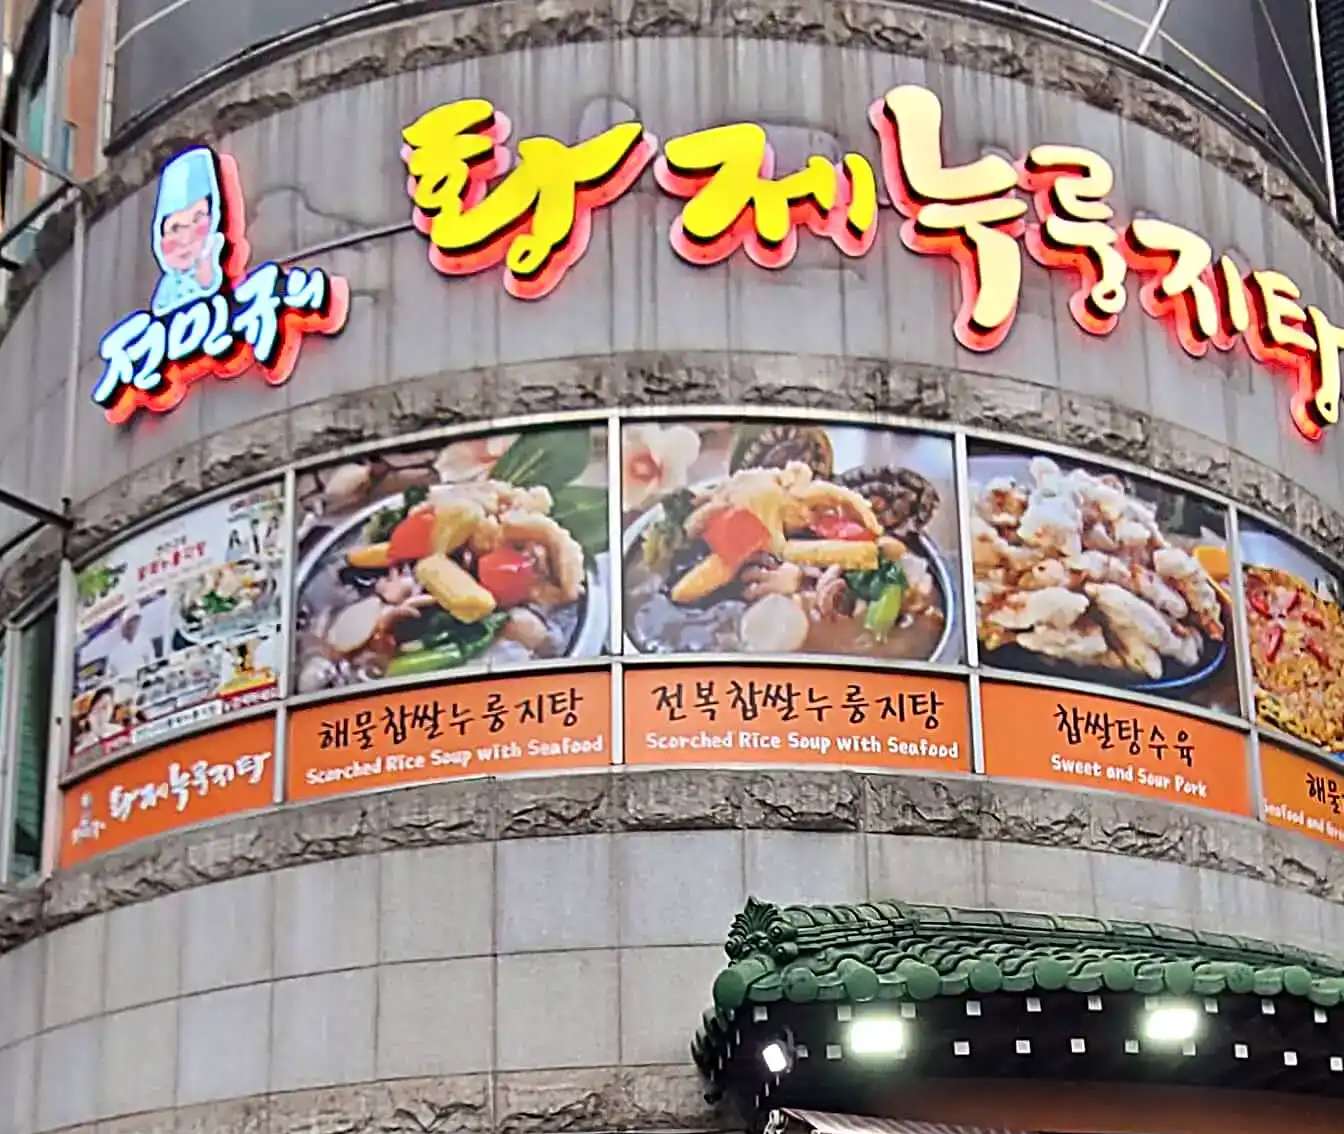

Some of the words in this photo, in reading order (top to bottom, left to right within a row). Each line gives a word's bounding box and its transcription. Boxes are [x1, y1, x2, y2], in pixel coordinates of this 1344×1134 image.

[92, 261, 330, 405] 전민규의
[318, 687, 584, 750] 해물찹쌀누룽지탕
[651, 680, 944, 730] 전복찹쌀누룽지탕
[306, 754, 382, 785] Scorched
[386, 753, 426, 773] Rice
[430, 749, 472, 768] Soup
[477, 742, 523, 762] with
[527, 735, 604, 757] Seafood
[646, 730, 733, 749] Scorched
[739, 730, 781, 749] Rice
[788, 731, 831, 755] Soup
[837, 734, 881, 754] with
[888, 736, 959, 759] Seafood
[1053, 703, 1195, 767] 찹쌀탕수육
[1050, 753, 1102, 778] Sweet
[1106, 764, 1135, 783] and
[1138, 767, 1171, 790] Sour
[1175, 775, 1208, 798] Pork
